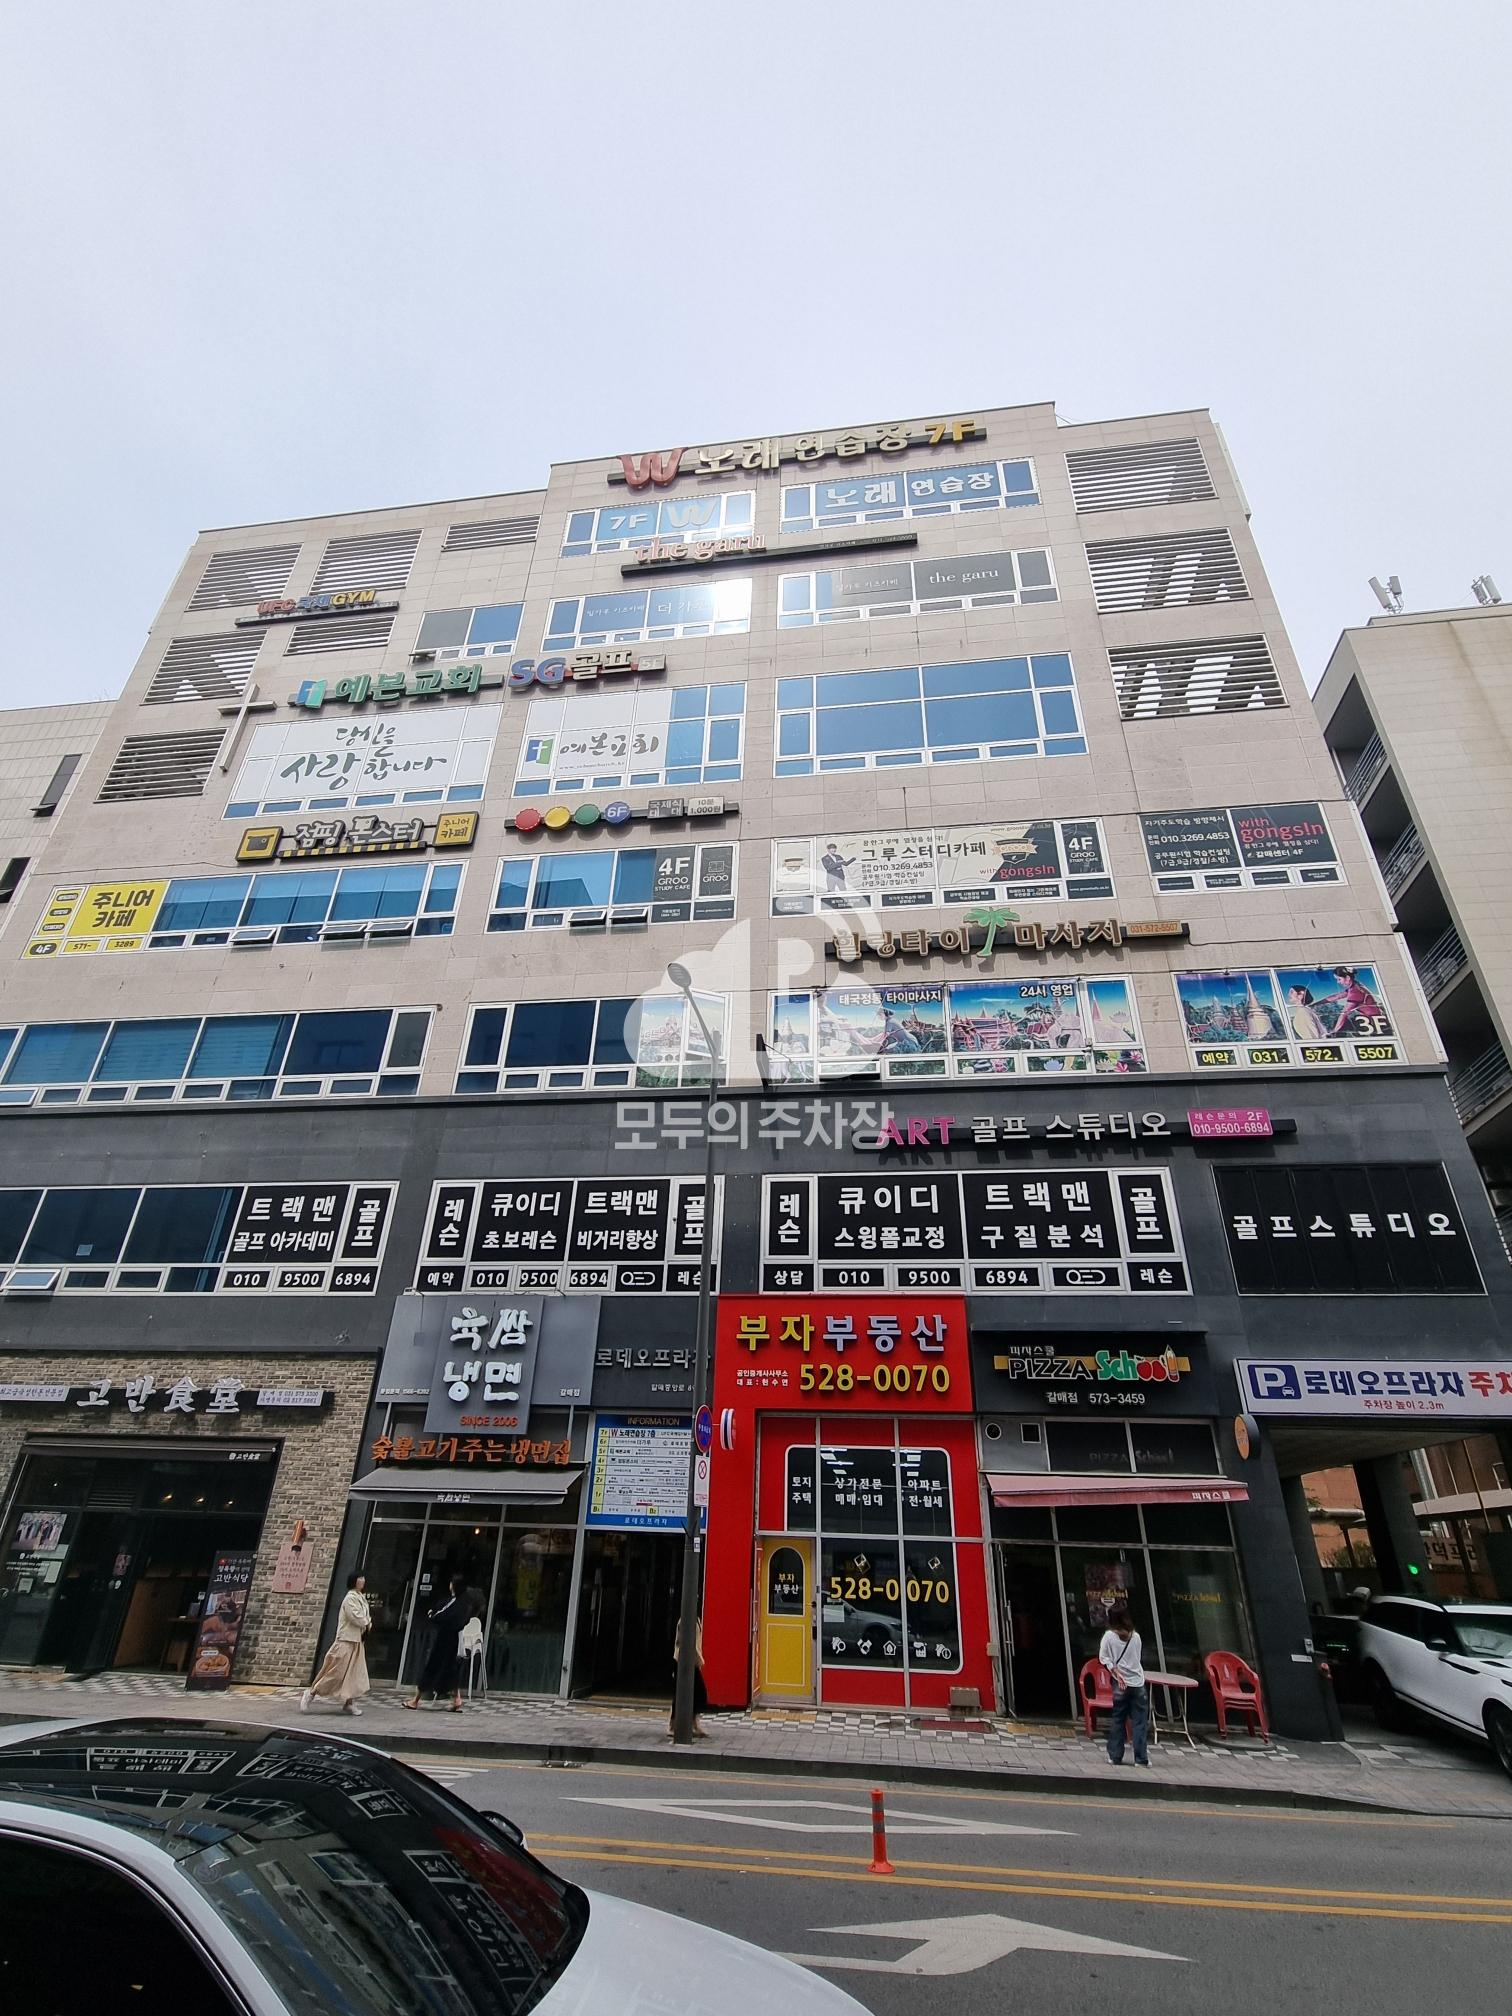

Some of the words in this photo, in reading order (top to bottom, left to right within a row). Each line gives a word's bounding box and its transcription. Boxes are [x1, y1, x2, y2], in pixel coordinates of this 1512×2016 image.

[924, 419, 976, 445] 7F
[610, 514, 648, 530] 7F
[635, 536, 688, 565] the
[694, 533, 767, 563] garu
[929, 571, 956, 584] the
[962, 568, 999, 583] garu
[332, 589, 376, 608] GYM
[508, 657, 567, 688] SG
[570, 650, 632, 681] 골프
[335, 663, 482, 704] 예본교회
[336, 723, 396, 758] 당신을
[559, 732, 660, 757] 예본교회
[607, 806, 628, 818] 6F
[296, 820, 346, 849] 점핑
[348, 815, 424, 844] 몬스터
[443, 818, 470, 828] 주니어
[1239, 817, 1269, 828] with
[440, 828, 467, 839] 카페
[1160, 831, 1230, 843] 010.3269.4853
[1068, 837, 1093, 851] 4F
[658, 857, 691, 876] 4F
[872, 861, 934, 872] 010.3269.4853
[657, 877, 689, 886] GROO
[703, 874, 729, 883] GROO
[92, 889, 155, 909] 주니어
[92, 909, 136, 928] 카페
[1013, 918, 1123, 949] 마사지
[35, 945, 52, 954] 4F
[838, 991, 883, 1007] 태국정통
[886, 988, 943, 1005] 타이마사지
[1020, 985, 1047, 998] 24시
[1050, 984, 1074, 997] 영업
[1355, 1015, 1387, 1036] 3F
[1202, 1052, 1229, 1064] 예약
[1358, 1046, 1393, 1060] 5507
[1247, 1111, 1264, 1121] 2F
[876, 1116, 956, 1146] ART
[970, 1114, 1031, 1144] 골프
[1045, 1111, 1172, 1142] 스튜디오
[1193, 1121, 1270, 1134] 010-9500-6894
[490, 1191, 561, 1217] 큐이디
[584, 1189, 659, 1216] 트랙맨
[837, 1184, 939, 1215] 큐이디
[984, 1180, 1092, 1213] 트랙맨
[247, 1195, 337, 1223] 트랙맨
[777, 1193, 801, 1244] 레슨
[1129, 1186, 1164, 1242] 골프
[351, 1199, 381, 1247] 골프
[438, 1198, 464, 1246] 레슨
[233, 1232, 265, 1252] 골프
[269, 1230, 335, 1252] 아카데미
[482, 1230, 557, 1250] 초보레슨
[577, 1228, 658, 1250] 비거리향상
[833, 1225, 946, 1251] 스윙폼교정
[980, 1223, 1104, 1250] 구질분석
[233, 1273, 260, 1286] 010
[283, 1272, 320, 1286] 9500
[335, 1272, 371, 1286] 6894
[427, 1272, 454, 1286] 예약
[476, 1272, 504, 1286] 010
[520, 1271, 559, 1286] 9500
[570, 1271, 608, 1286] 6894
[773, 1269, 804, 1286] 상담
[838, 1270, 871, 1286] 010
[908, 1269, 951, 1286] 9500
[985, 1268, 1029, 1285] 6894
[1140, 1266, 1174, 1285] 레슨
[450, 1306, 534, 1351] 육쌈
[1009, 1345, 1055, 1356] 피자스쿨
[799, 1363, 950, 1393] 528-0070
[1008, 1358, 1094, 1381] PIZZA
[442, 1361, 523, 1402] 냉면
[1304, 1370, 1466, 1397] 로데오프라자
[1046, 1391, 1079, 1404] 갈매점
[1089, 1392, 1146, 1405] 573-3459
[1363, 1399, 1393, 1410] 주차장
[1396, 1399, 1416, 1411] 높이
[1418, 1400, 1445, 1410] 2.3m
[460, 1415, 489, 1427] SINCE
[493, 1415, 518, 1427] 2006
[627, 1417, 680, 1426] INFORMATION
[791, 1476, 812, 1488] 토지
[907, 1479, 942, 1491] 아파트
[791, 1492, 812, 1505] 주택
[778, 1573, 795, 1583] 부자
[774, 1584, 799, 1595] 부동산
[830, 1576, 950, 1604] 528-0070
